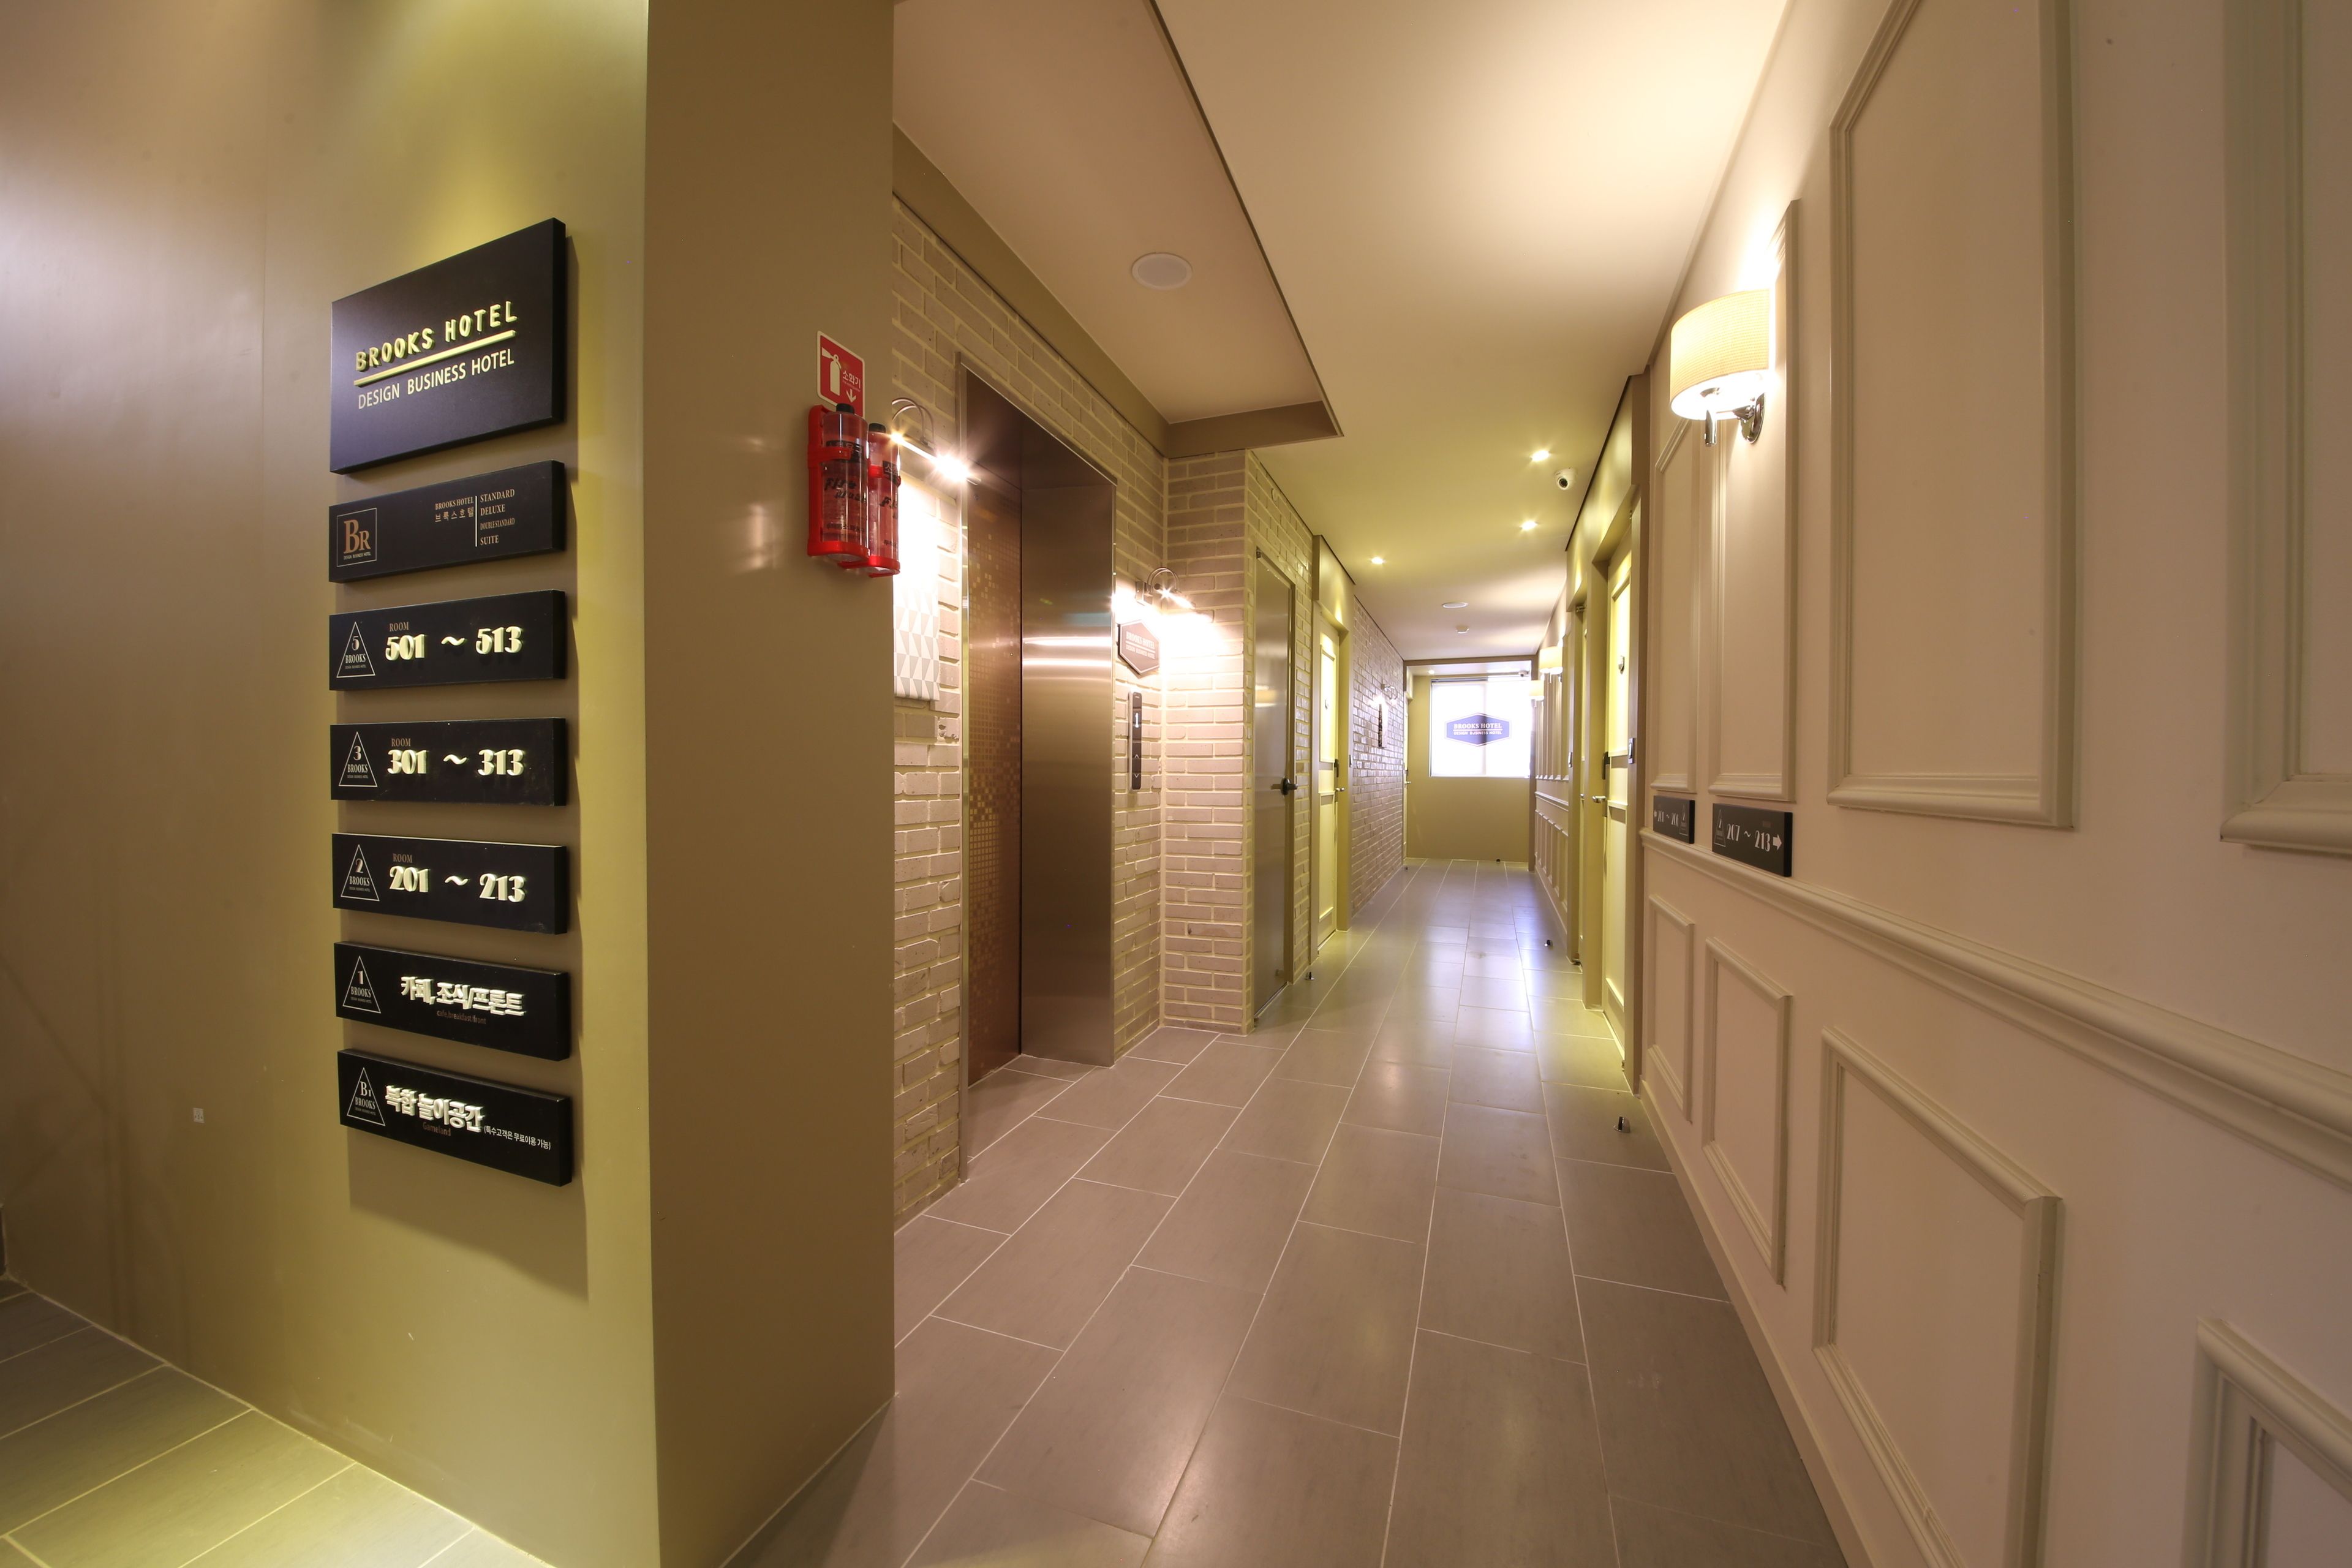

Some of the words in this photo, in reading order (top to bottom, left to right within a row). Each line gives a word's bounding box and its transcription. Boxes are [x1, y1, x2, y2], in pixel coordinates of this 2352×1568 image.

[355, 328, 434, 372] BROOKS
[445, 301, 518, 343] HOTEL
[358, 383, 400, 410] DESIGN
[407, 362, 466, 395] BUSINESS
[472, 349, 514, 375] HOTEL
[843, 370, 861, 389] 소화기
[435, 499, 456, 510] BROOKS
[456, 496, 474, 507] HOTEL
[480, 489, 515, 503] STANDARD
[480, 503, 505, 516] DELUXE
[344, 519, 371, 554] BR
[480, 535, 499, 546] SUITE
[389, 622, 409, 631] ROOM
[352, 635, 360, 651] 5
[385, 633, 426, 661] 501
[475, 626, 523, 655] 513
[345, 654, 366, 663] BROOKS
[391, 738, 411, 747] ROOM
[353, 745, 362, 761] 3
[347, 764, 368, 773] BROOKS
[387, 749, 428, 775] 301
[477, 748, 526, 776] 313
[1727, 823, 1740, 842] 207
[1755, 830, 1771, 852] 213
[355, 858, 363, 873] 2
[393, 853, 413, 863] ROOM
[349, 876, 370, 886] BROOKS
[389, 865, 430, 893] 201
[479, 873, 527, 903] 213
[357, 970, 364, 984] 1
[351, 986, 372, 998] BROOKS
[355, 1096, 375, 1110] BROOKS
[385, 1085, 418, 1116] 복합
[417, 1093, 485, 1133] 놀이공간
[422, 1121, 451, 1137] Gameland
[484, 1125, 513, 1140] (특수고객은
[514, 1133, 537, 1146] 무료이용
[537, 1139, 551, 1150] 가능)
